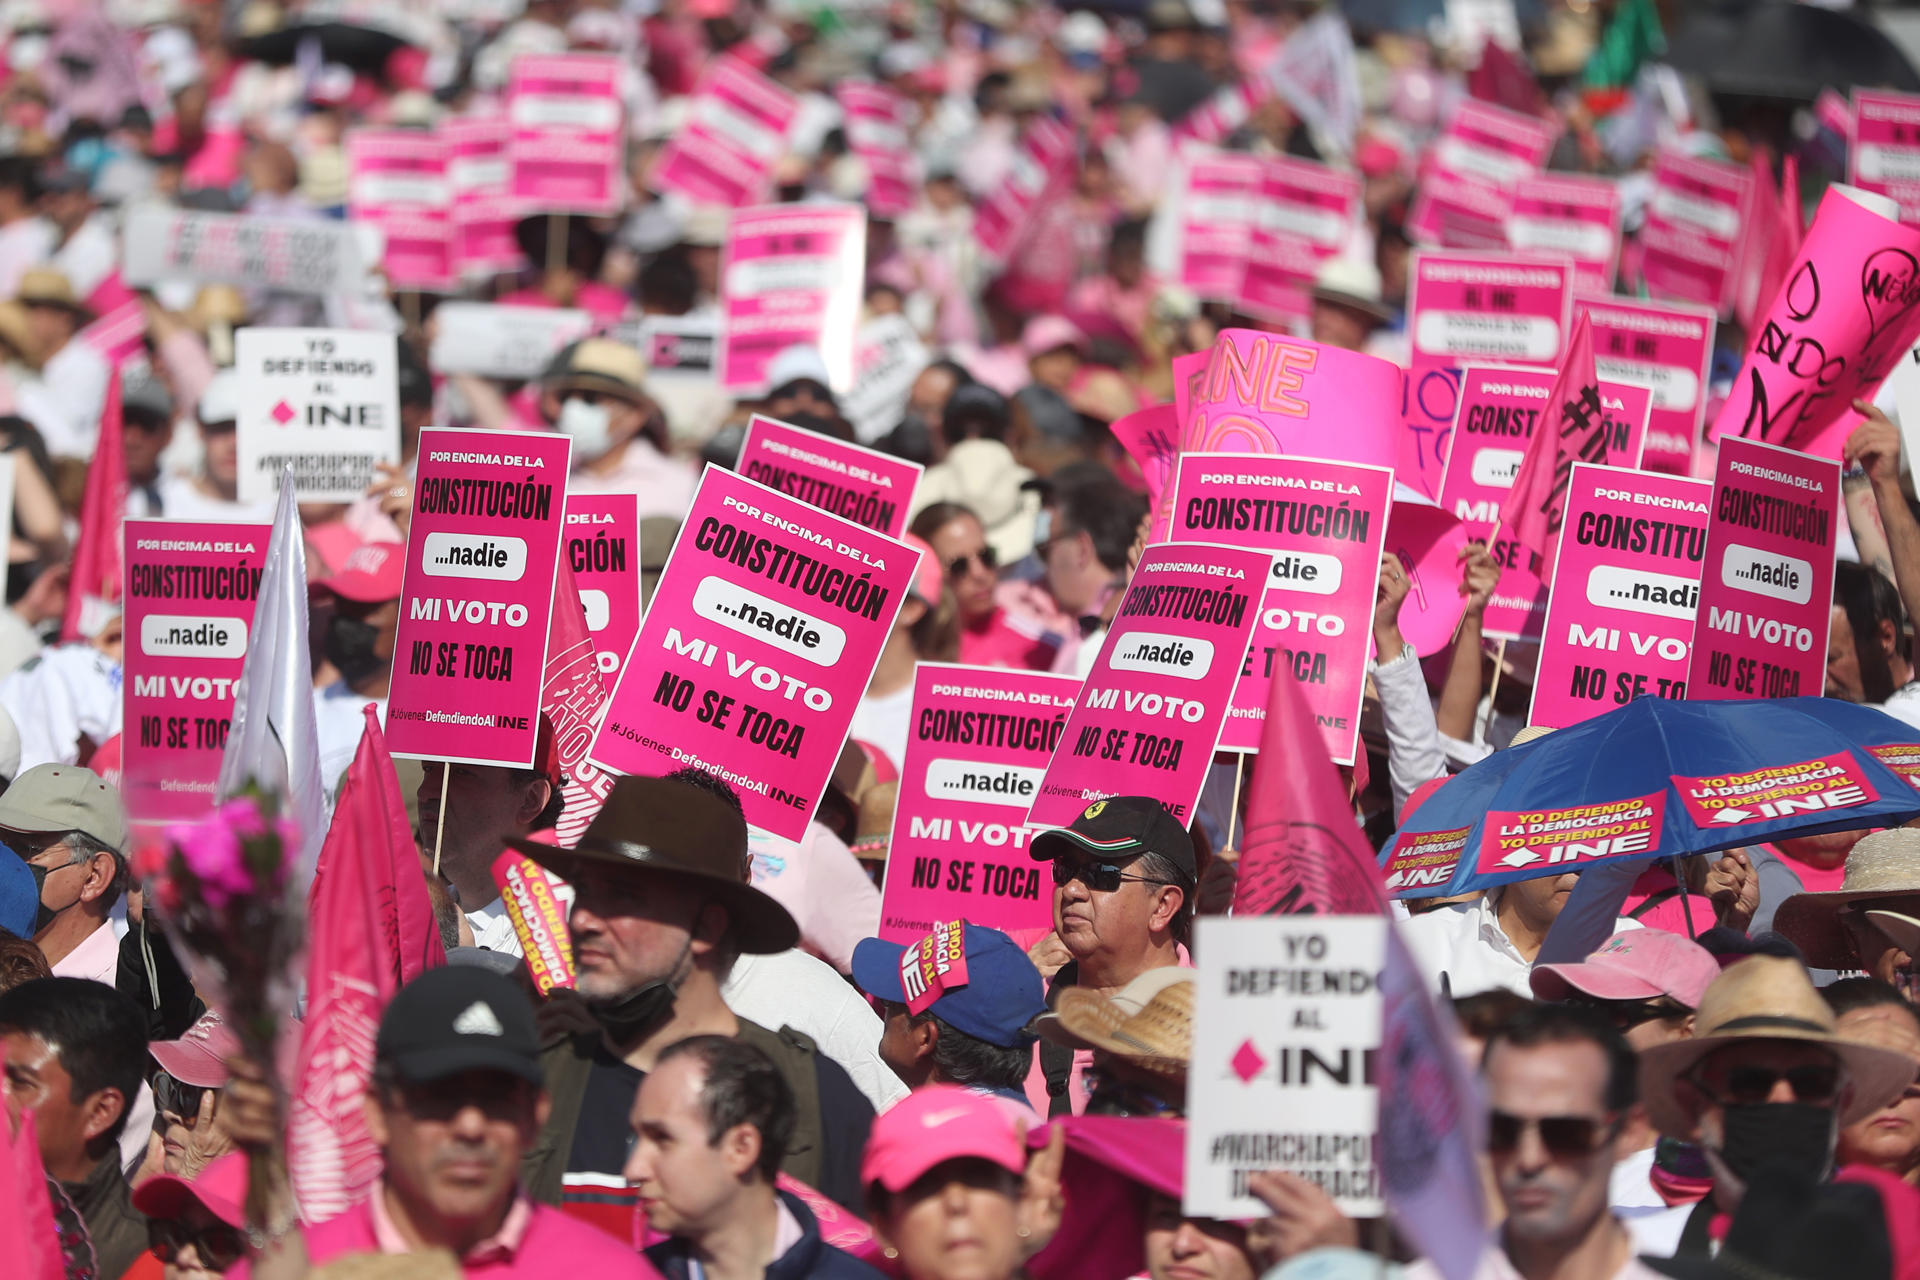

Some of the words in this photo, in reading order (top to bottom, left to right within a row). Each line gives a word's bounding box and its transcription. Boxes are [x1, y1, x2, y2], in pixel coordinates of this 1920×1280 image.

[1481, 382, 1511, 396] POR
[1513, 384, 1550, 399] ENCI
[1602, 396, 1624, 410] LA
[307, 404, 384, 429] INE
[430, 452, 450, 462] POR
[452, 452, 501, 465] ENCIMA
[503, 455, 523, 467] DE
[525, 457, 544, 468] LA
[761, 438, 789, 455] POR
[789, 448, 848, 474] ENCIMA
[849, 465, 870, 481] DE
[870, 472, 892, 488] LA
[1201, 474, 1235, 485] POR
[1236, 475, 1307, 490] ENCIMA
[1310, 480, 1334, 492] DE
[1337, 483, 1361, 496] LA
[1730, 461, 1752, 475] POR
[1753, 466, 1794, 486] ENCIMA
[1795, 476, 1808, 489] DE
[1809, 481, 1823, 493] LA
[420, 474, 552, 520] CONSTITUCIÓN
[748, 460, 896, 532] CONSTITUCIÓN
[1456, 499, 1500, 523] MI
[1594, 488, 1632, 502] POR
[1634, 494, 1709, 514] ENCIMA
[567, 514, 590, 524] DE
[592, 513, 615, 524] LA
[1186, 497, 1370, 543] CONSTITUCIÓN
[1718, 485, 1829, 547] CONSTITUCIÓN
[137, 540, 159, 550] POR
[161, 540, 212, 552] ENCIMA
[214, 542, 233, 552] DE
[235, 542, 256, 553] LA
[723, 496, 761, 519] POR
[761, 512, 834, 550] ENCIMA
[835, 542, 860, 561] DE
[861, 551, 886, 571] LA
[1577, 511, 1707, 562] CONSTITU
[435, 543, 508, 567] ...nadie
[695, 516, 889, 622] CONSTITUCIÓN
[1144, 563, 1163, 572] POR
[1164, 563, 1205, 574] ENCIMA
[1207, 566, 1225, 576] DE
[1226, 569, 1245, 580] LA
[1736, 561, 1800, 590] ...nadie
[1122, 584, 1248, 628] CONSTITUCIÓN
[1610, 583, 1698, 609] ...nadi
[410, 598, 441, 621] MI
[446, 599, 528, 627] VOTO
[715, 602, 821, 648] ...nadie
[1259, 608, 1345, 637] OTO
[155, 624, 228, 646] ...nadie
[1568, 623, 1620, 652] MI
[1629, 632, 1693, 661] VO
[1708, 606, 1742, 635] MI
[1746, 614, 1813, 652] VOTO
[410, 641, 432, 675] NO
[436, 642, 458, 677] SE
[464, 644, 512, 682] TOCA
[1123, 642, 1194, 666] ...nadie
[662, 628, 718, 667] MI
[726, 651, 833, 712] VOTO
[1570, 665, 1607, 701] NO
[1708, 650, 1731, 688] NO
[1735, 657, 1757, 694] SE
[1761, 662, 1800, 698] TOCA
[134, 675, 166, 698] MI
[932, 685, 962, 697] POR
[963, 687, 1026, 703] ENCIMA
[1028, 693, 1051, 706] DE
[1053, 696, 1076, 708] LA
[653, 671, 695, 713] NO
[697, 690, 736, 731] SE
[736, 704, 805, 759] TOCA
[1085, 688, 1120, 709] MI
[1125, 690, 1205, 723] VOTO
[140, 715, 161, 748] NO
[167, 717, 188, 749] SE
[195, 718, 231, 750] TOC
[919, 708, 1066, 753] CONSTITUCIÓ
[1313, 714, 1348, 729] NE
[1073, 726, 1102, 757] NO
[1100, 729, 1128, 761] SE
[1129, 732, 1183, 771] TOCA
[943, 772, 1034, 795] ...nadie
[1691, 786, 1717, 799] LA
[1718, 766, 1846, 797] DEMOCRACIA
[1699, 777, 1727, 789] YO
[1728, 761, 1827, 786] DEFIENDO
[769, 788, 808, 810] INE
[1697, 797, 1726, 810] YO
[1727, 782, 1825, 809] DEFIENDO
[1828, 777, 1855, 791] AL
[1759, 786, 1868, 819] INE
[1160, 802, 1186, 816] NE
[1500, 824, 1526, 836] LA
[1529, 806, 1653, 834] DEMOCRACIA
[1518, 813, 1545, 825] YO
[1548, 799, 1644, 822] DEFIENDO
[910, 816, 952, 841] MI
[1499, 836, 1526, 849] YO
[1527, 824, 1624, 847] DEFIENDO
[1627, 820, 1651, 833] AL
[1398, 846, 1414, 857] LA
[1413, 838, 1467, 855] DEMOCRAC
[1548, 832, 1651, 864] INE
[912, 856, 941, 889] NO
[947, 860, 975, 892] SE
[982, 863, 1040, 900] TOCA
[1402, 863, 1456, 886] INE
[502, 885, 546, 975] DEFIENDO
[506, 863, 567, 984] DEMOCRACIA
[1284, 934, 1328, 960] YO
[902, 940, 927, 1001] NE
[923, 963, 936, 985] AL
